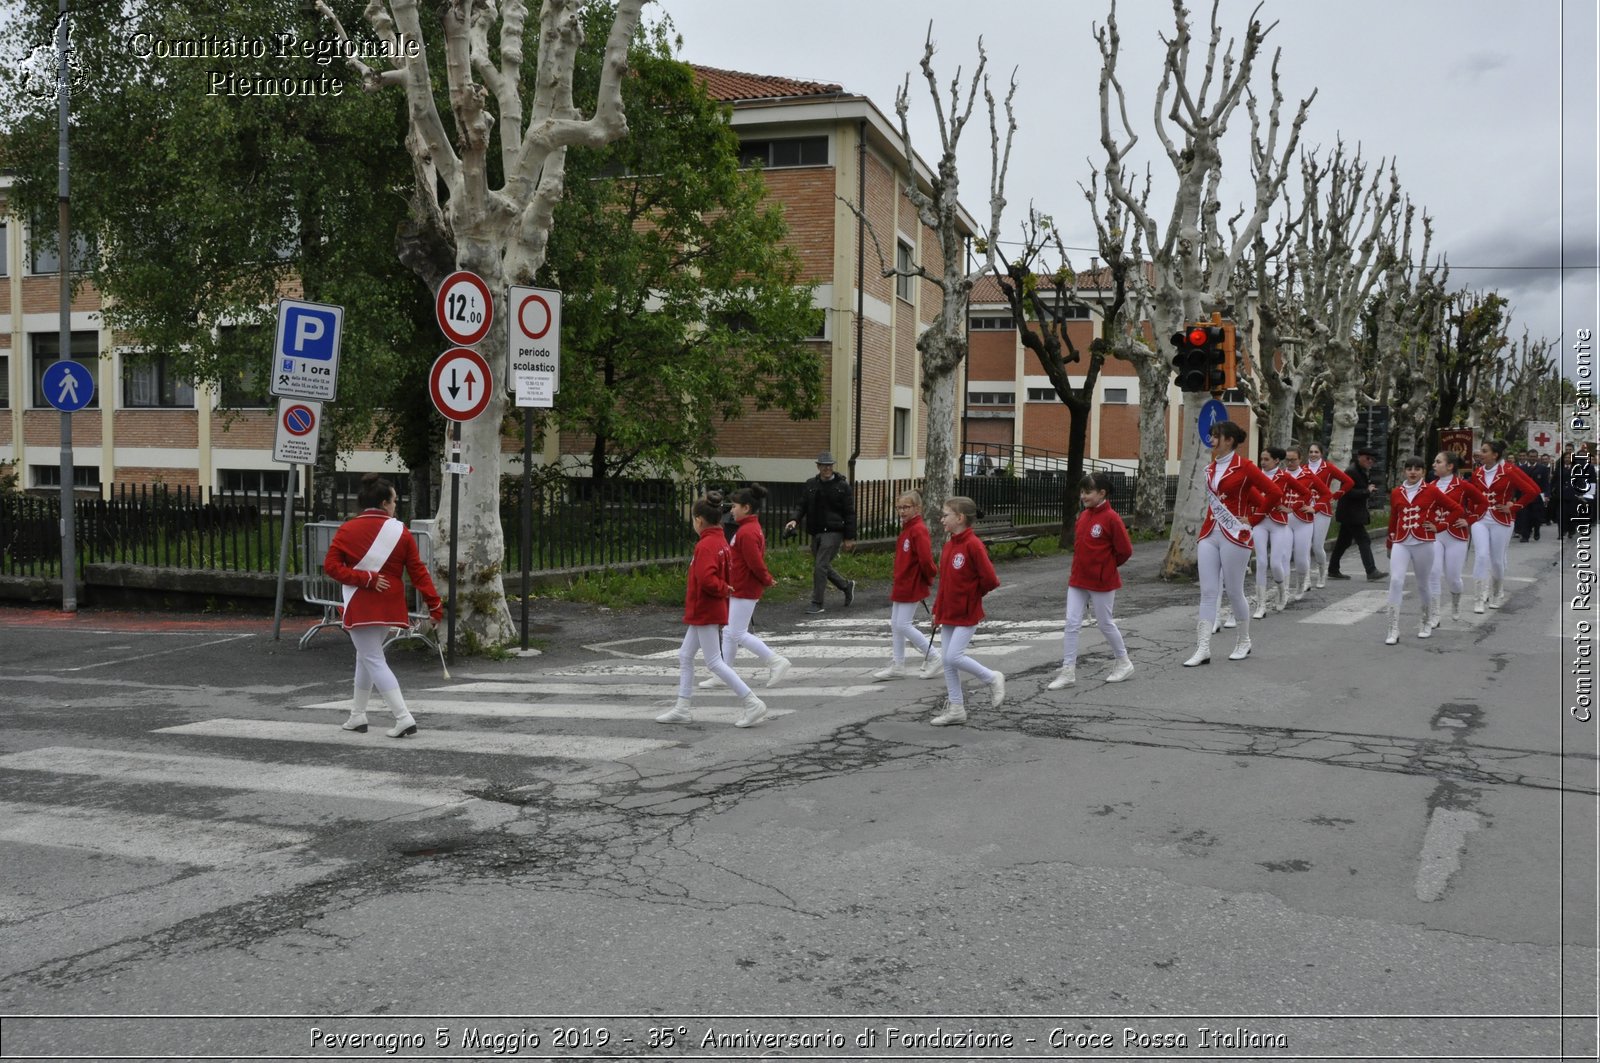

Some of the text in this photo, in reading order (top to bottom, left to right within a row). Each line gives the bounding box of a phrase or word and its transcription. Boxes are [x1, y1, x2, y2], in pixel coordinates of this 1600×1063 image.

[294, 315, 324, 351] P
[519, 347, 550, 357] periodo
[302, 363, 330, 375] 1 ora
[513, 362, 555, 372] scolastico
